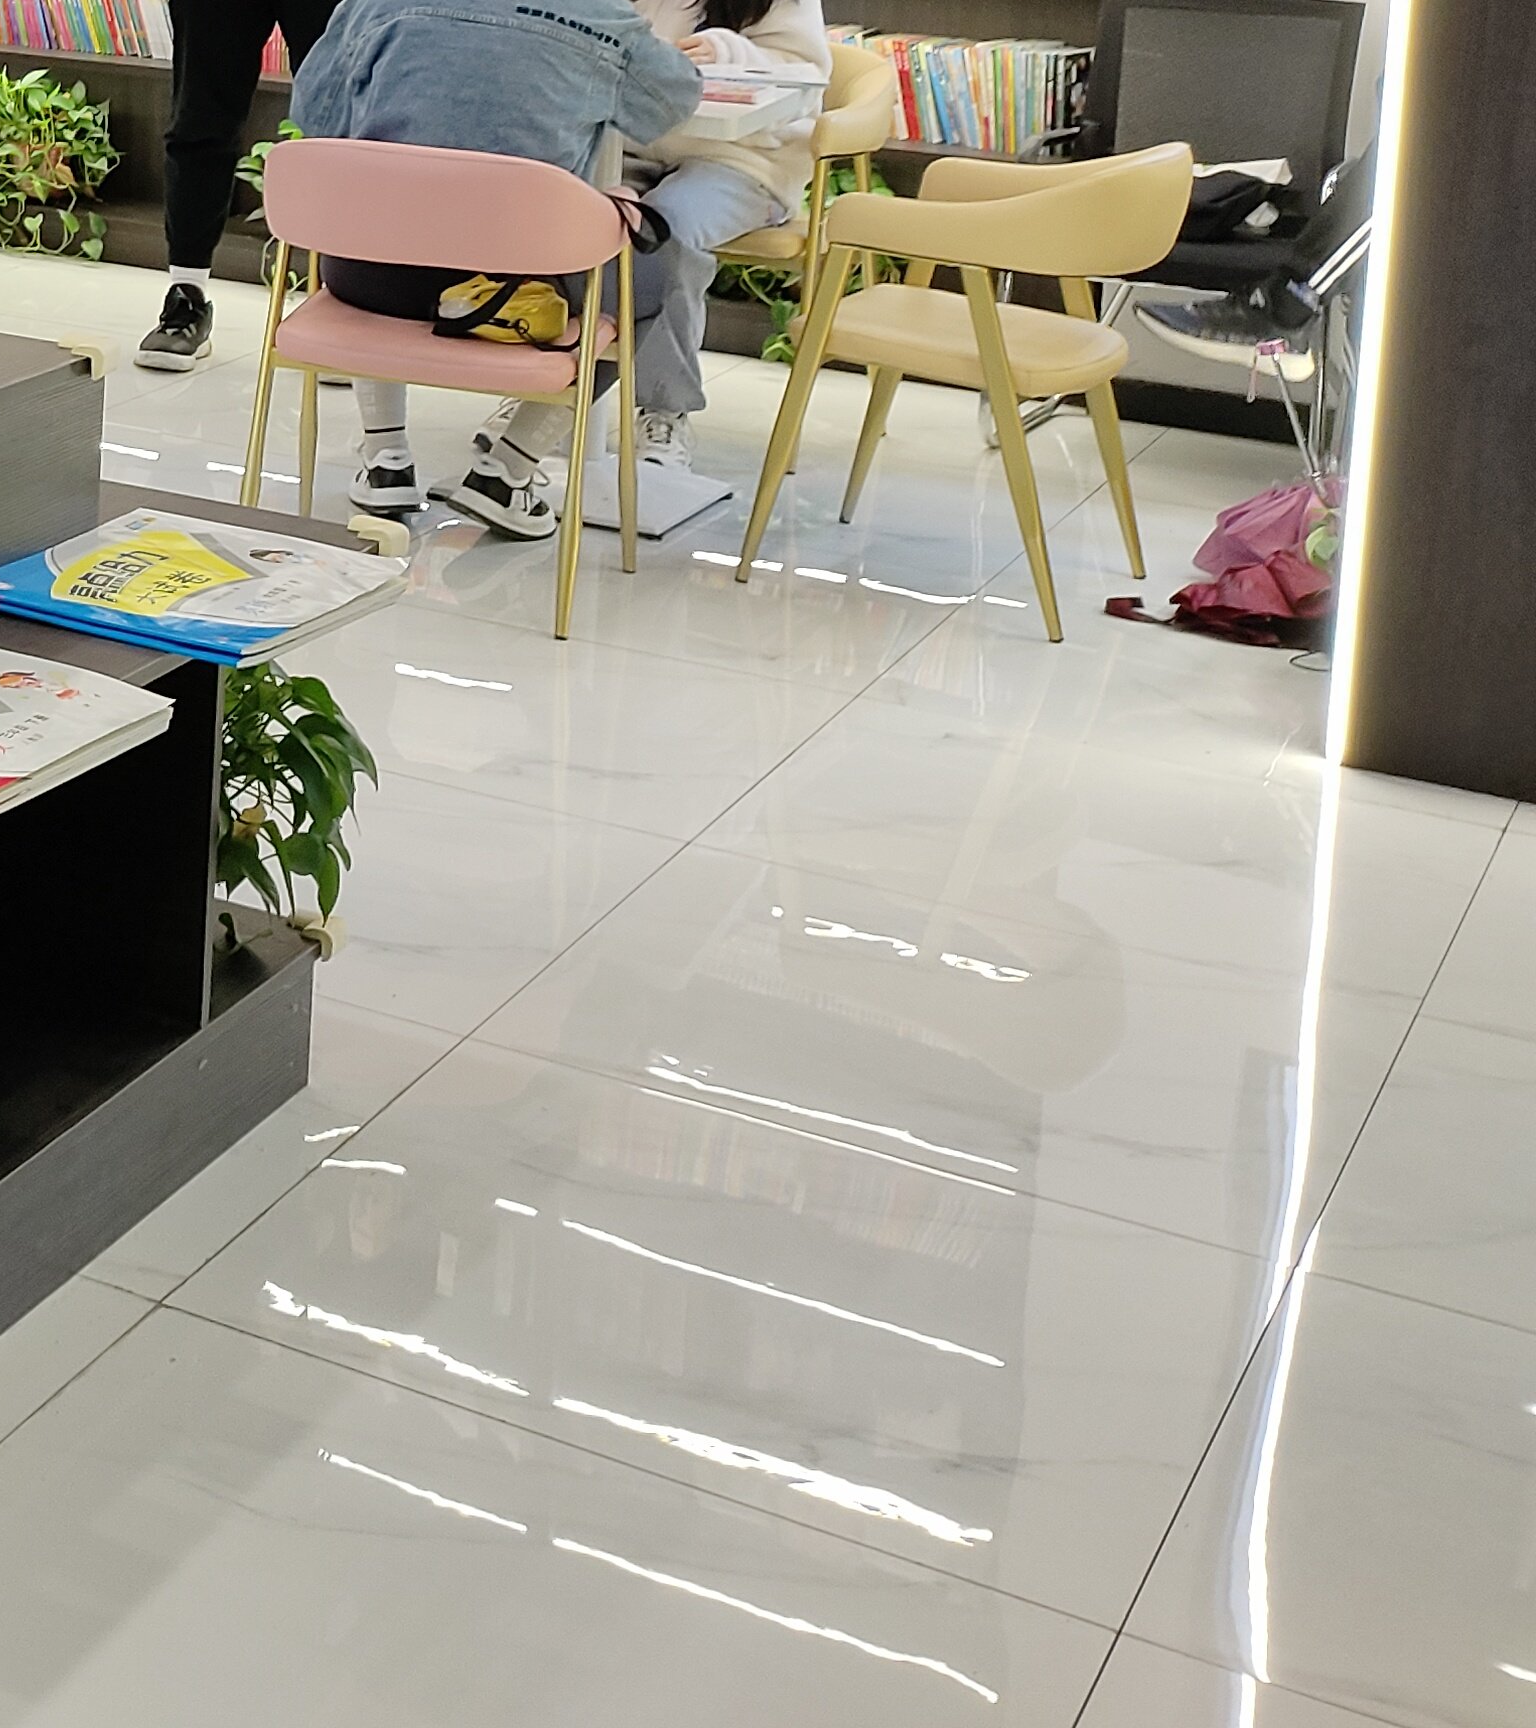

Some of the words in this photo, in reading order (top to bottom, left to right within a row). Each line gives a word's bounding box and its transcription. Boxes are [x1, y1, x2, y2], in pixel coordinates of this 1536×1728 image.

[68, 549, 170, 603] 亮点给力
[136, 569, 212, 604] 大试卷
